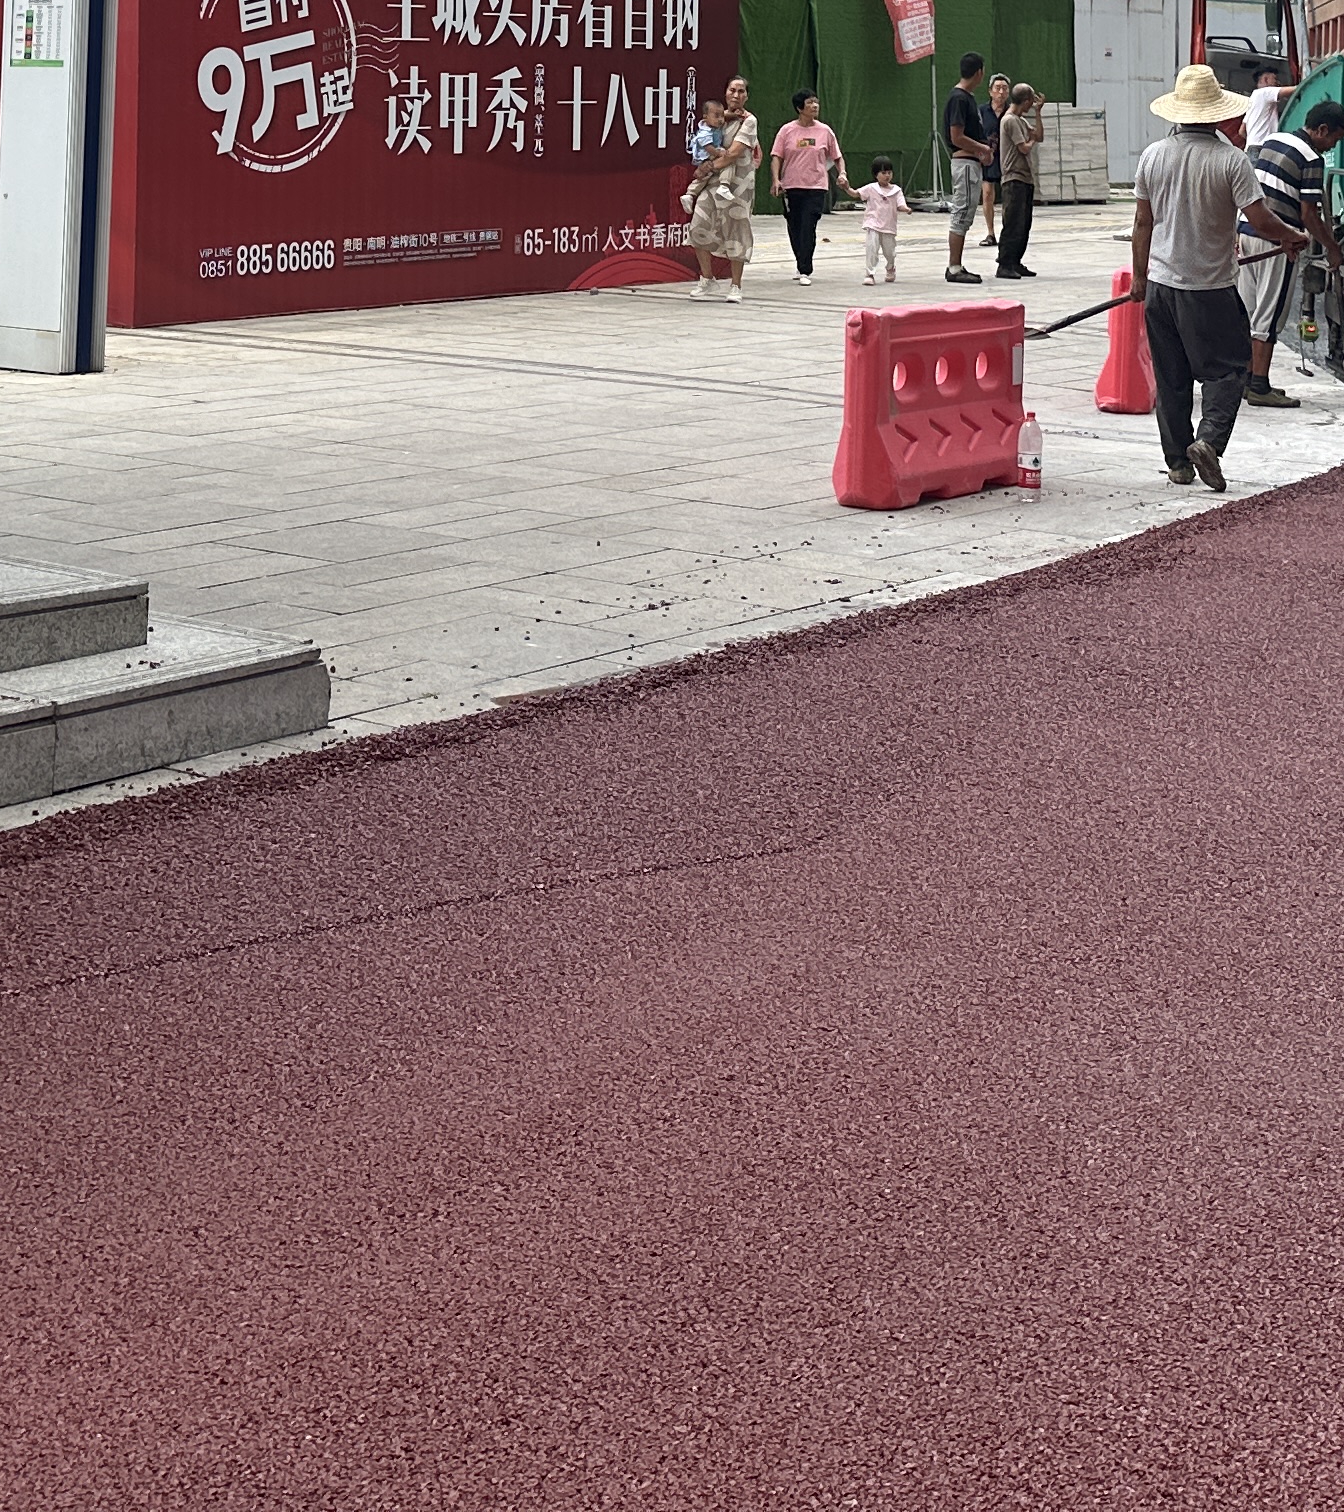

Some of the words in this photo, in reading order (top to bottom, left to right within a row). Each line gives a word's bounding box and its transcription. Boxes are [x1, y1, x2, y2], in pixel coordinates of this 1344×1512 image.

[384, 65, 528, 155] 读甲秀
[557, 66, 681, 152] 十八中
[199, 260, 232, 278] 0851
